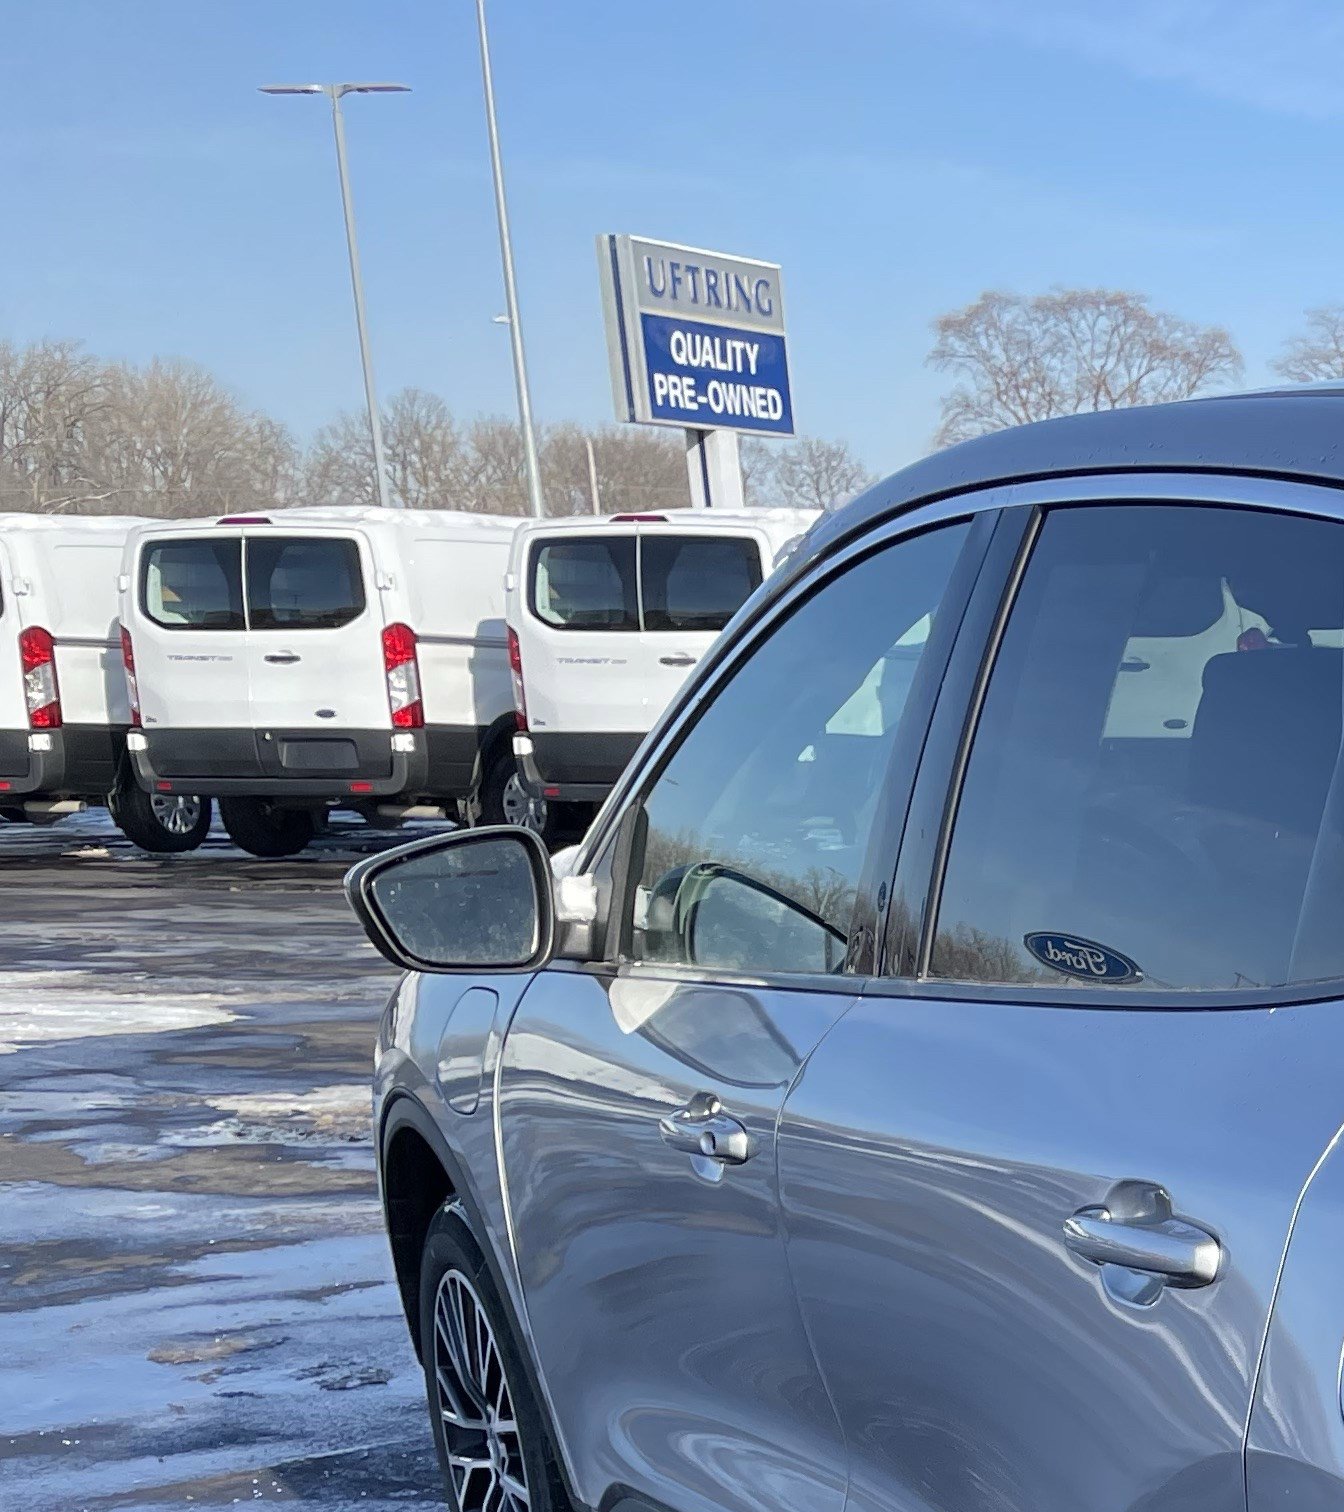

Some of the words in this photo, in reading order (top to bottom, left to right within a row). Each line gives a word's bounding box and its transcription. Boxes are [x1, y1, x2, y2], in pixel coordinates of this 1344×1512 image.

[645, 255, 772, 317] UFTRING
[670, 329, 760, 375] QUALITY
[653, 371, 784, 420] PRE-OWNED
